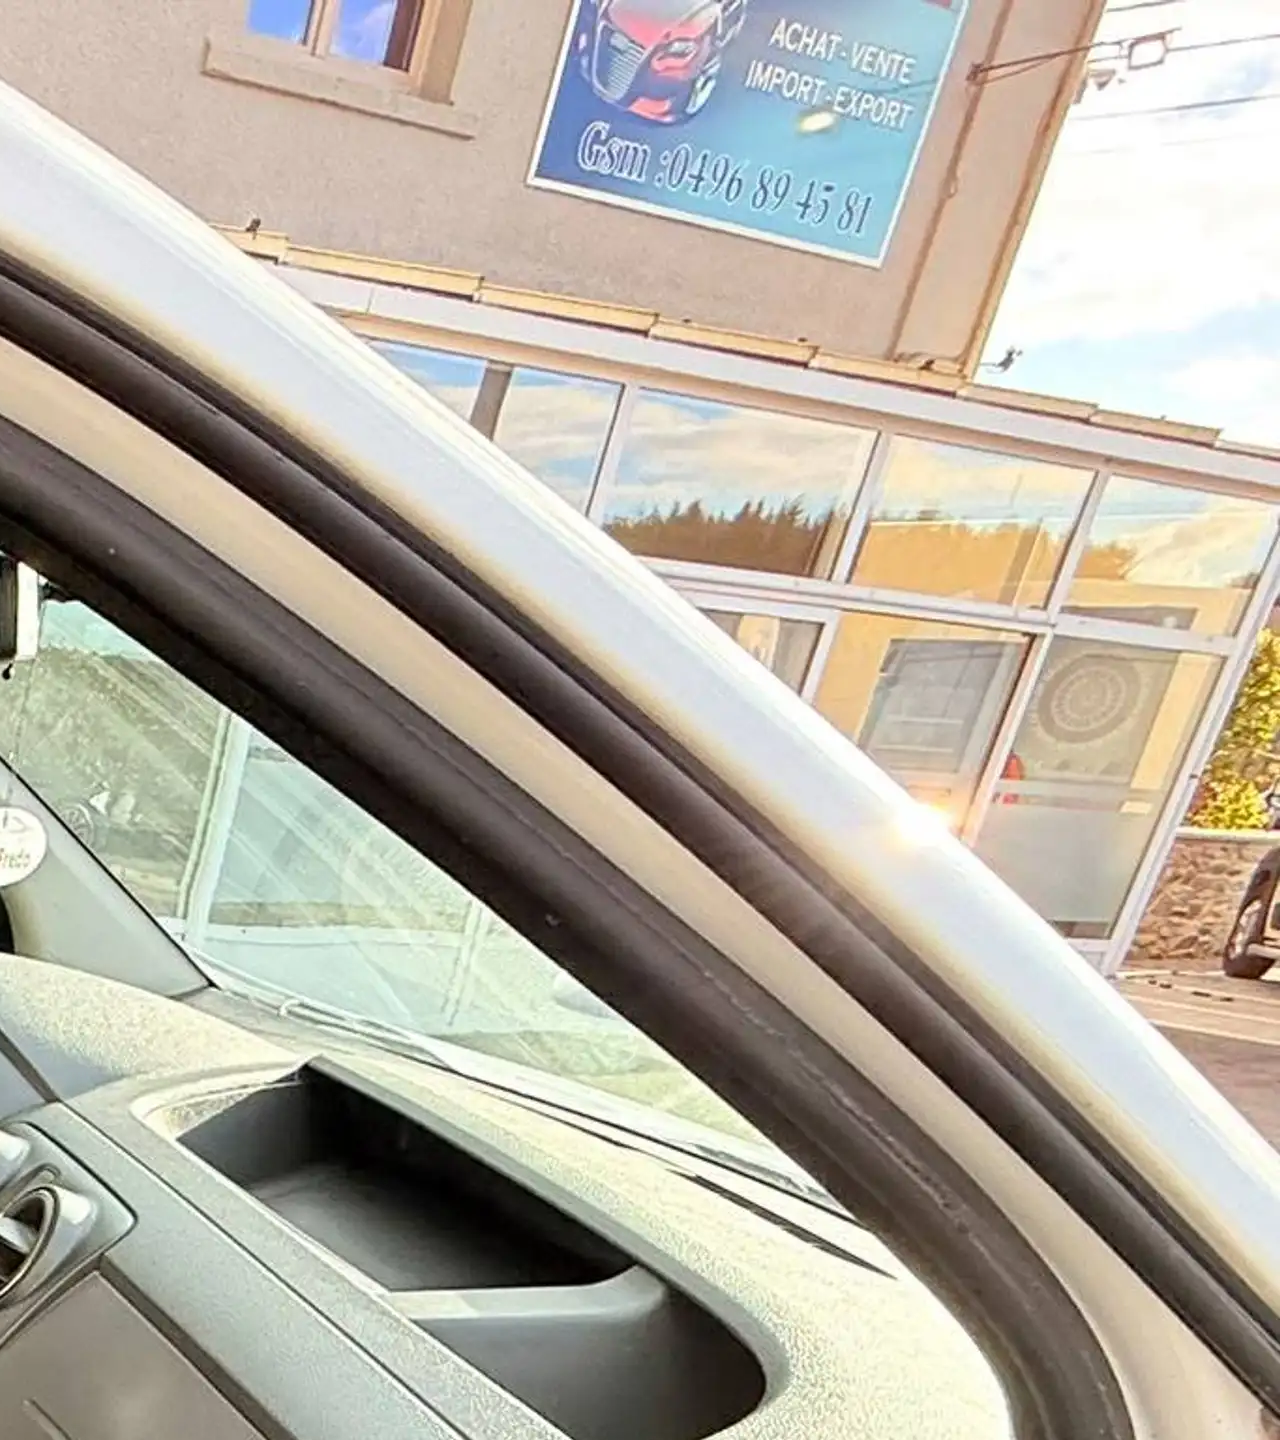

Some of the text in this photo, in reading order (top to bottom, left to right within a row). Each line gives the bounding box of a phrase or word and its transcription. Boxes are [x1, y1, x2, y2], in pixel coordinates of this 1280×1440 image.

[577, 120, 651, 184] Gsm
[751, 164, 791, 212] 89
[796, 177, 836, 226] 45
[836, 187, 876, 236] 81
